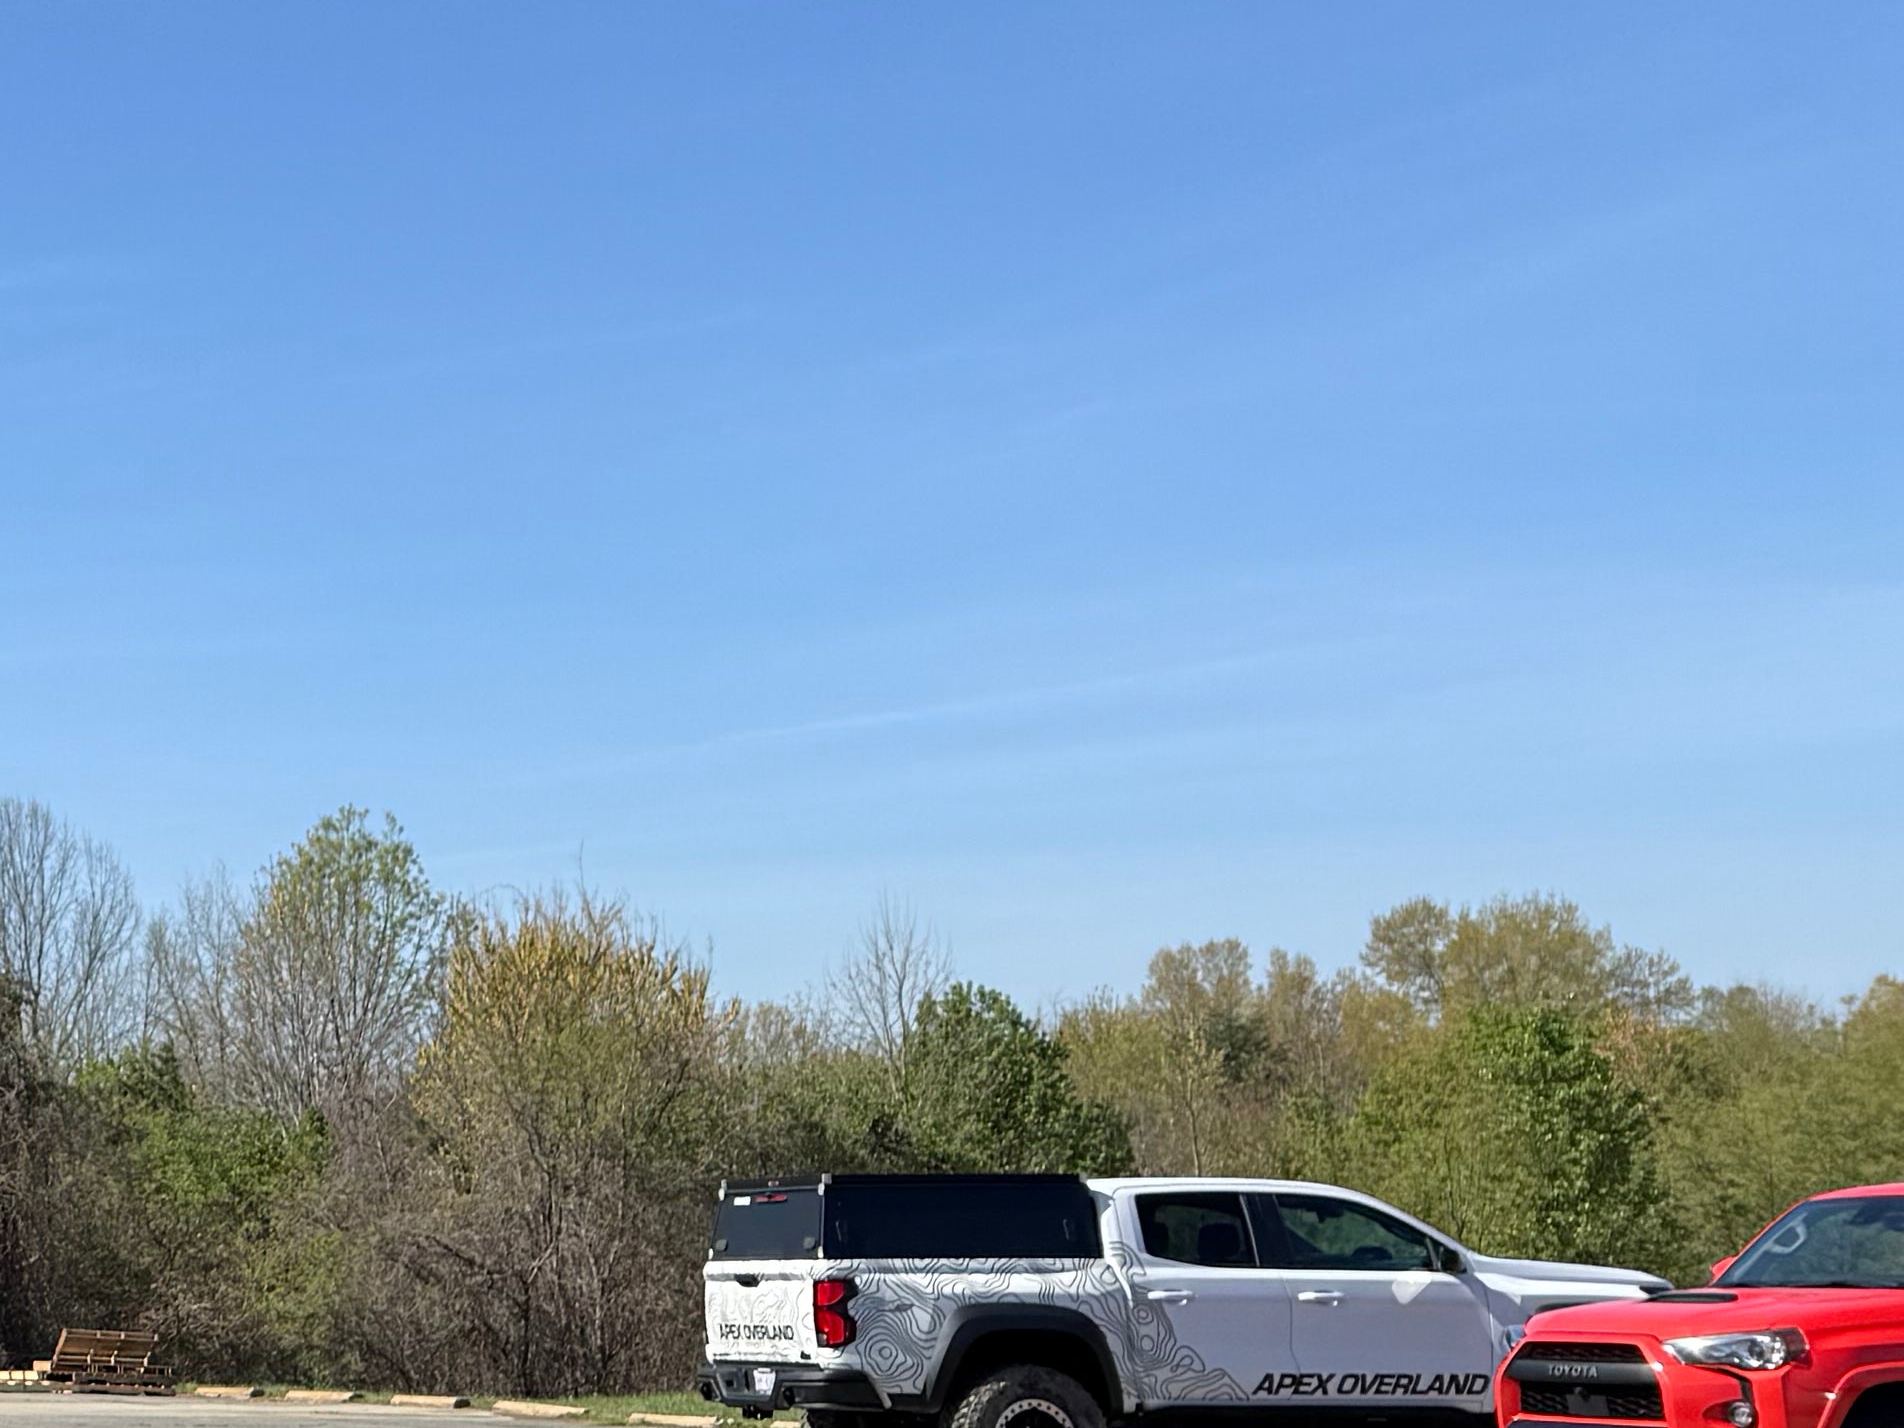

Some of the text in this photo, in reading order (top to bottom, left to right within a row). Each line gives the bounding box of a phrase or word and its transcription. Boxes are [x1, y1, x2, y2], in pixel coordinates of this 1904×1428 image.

[1548, 1364, 1598, 1378] TOYOTA
[1251, 1373, 1491, 1396] APEX OVERLAND
